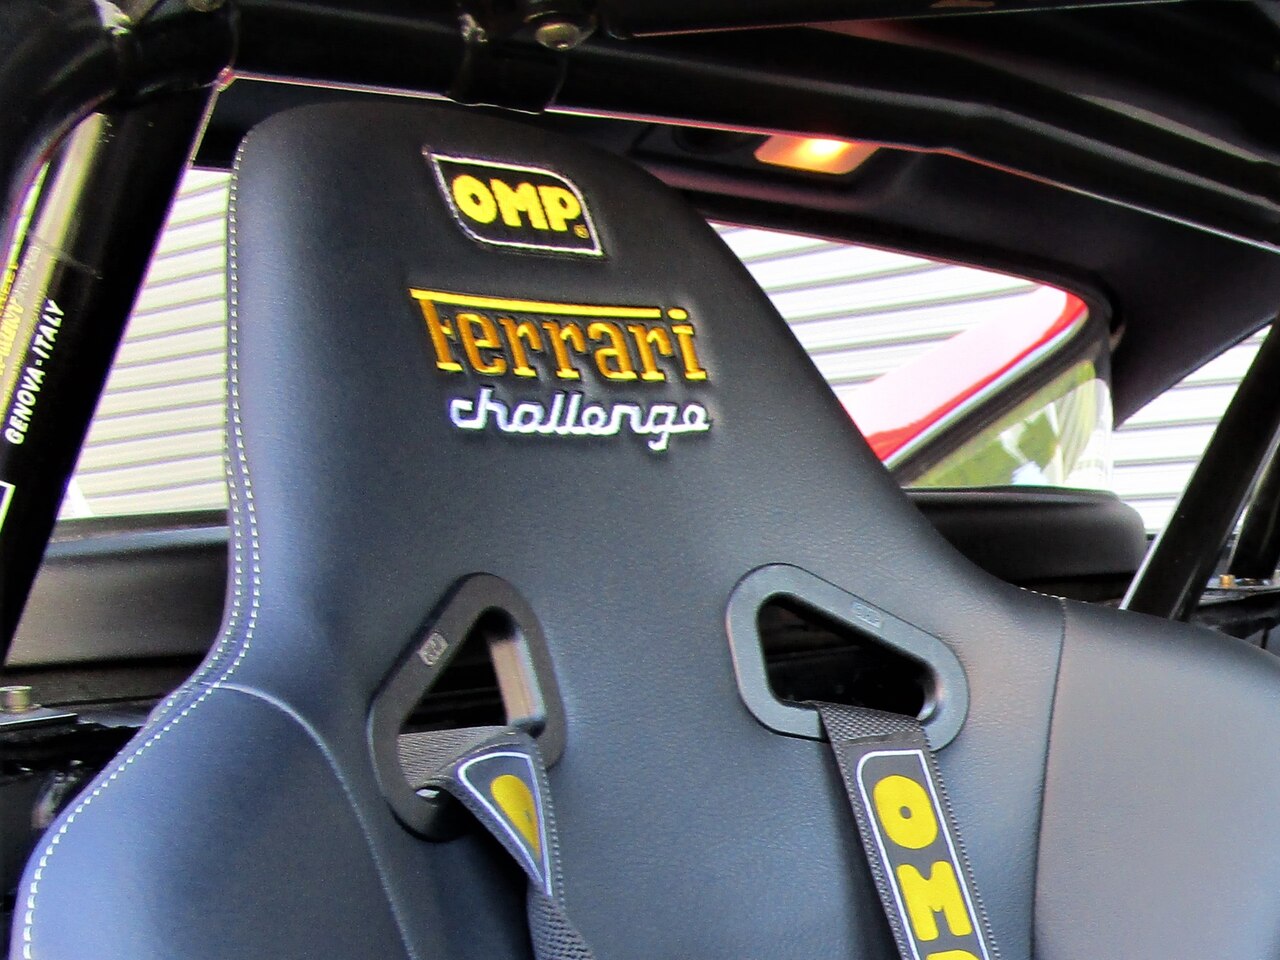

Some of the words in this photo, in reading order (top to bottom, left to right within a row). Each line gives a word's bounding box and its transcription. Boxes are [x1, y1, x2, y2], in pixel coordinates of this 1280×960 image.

[452, 174, 582, 232] OMP
[409, 288, 708, 381] Ferrari
[450, 387, 712, 451] challenge
